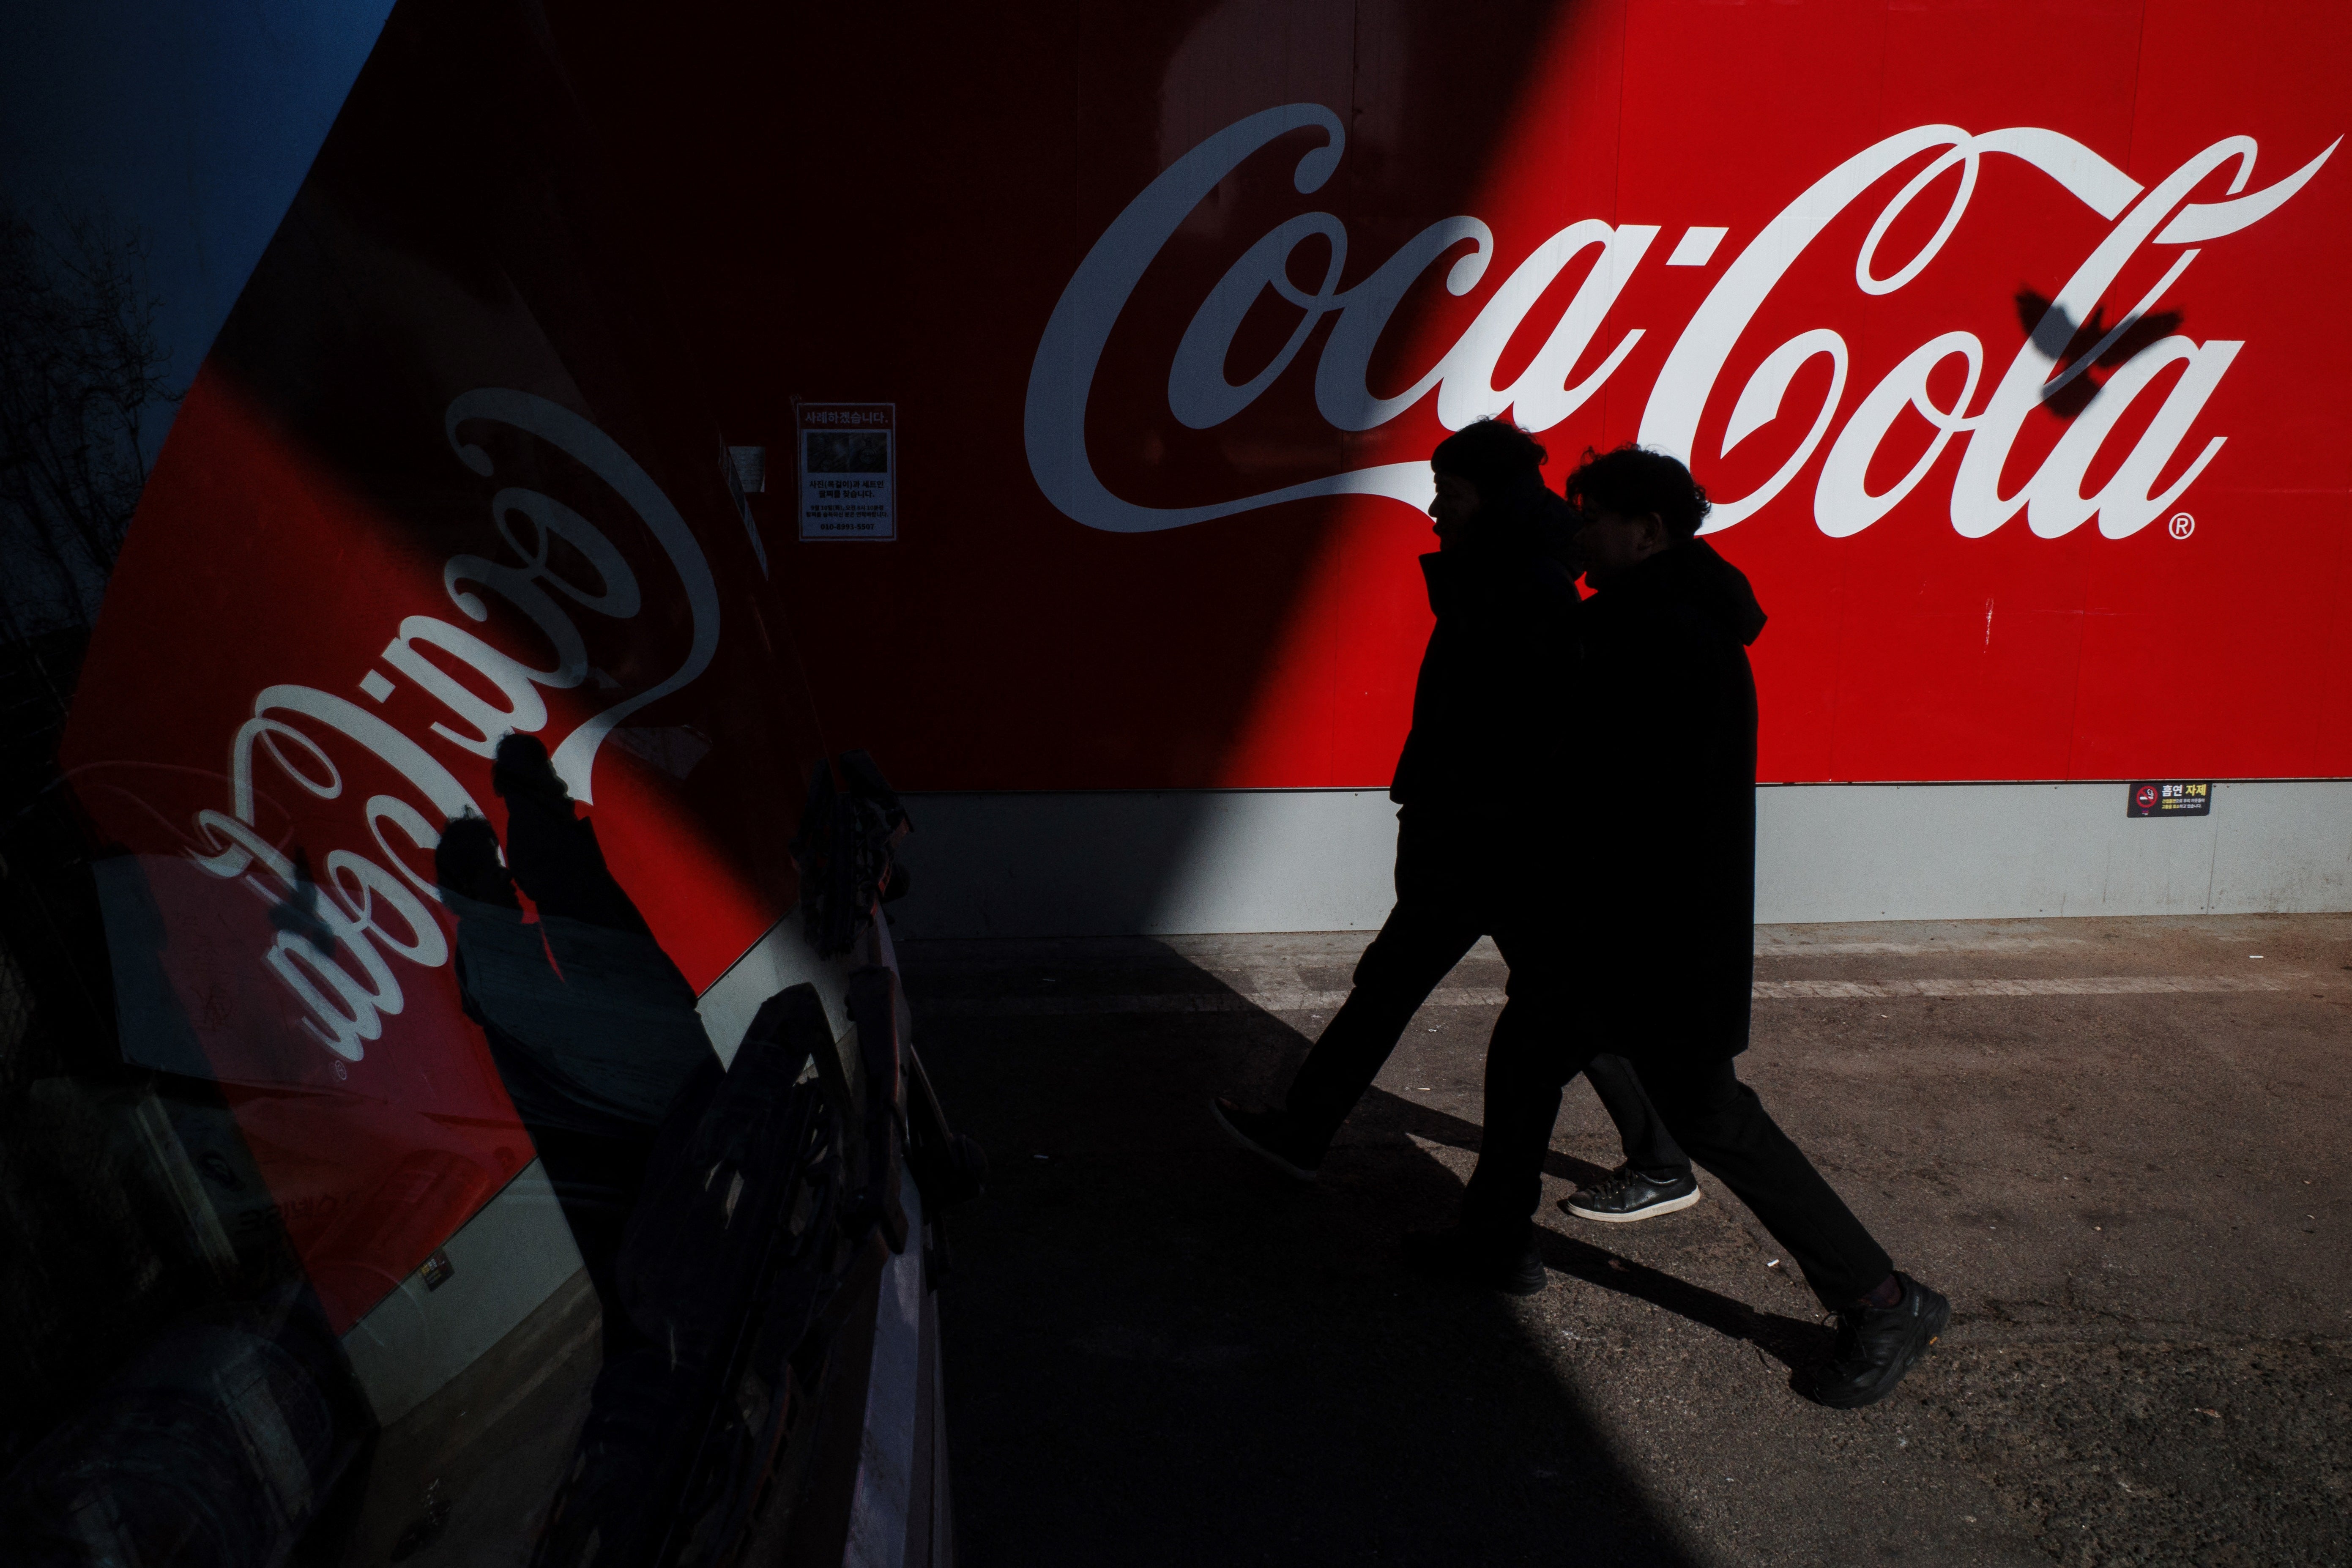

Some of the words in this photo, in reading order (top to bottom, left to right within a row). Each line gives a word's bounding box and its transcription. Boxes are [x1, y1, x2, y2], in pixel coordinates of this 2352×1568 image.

[1024, 102, 2342, 540] Coca-Cola
[805, 411, 888, 424] 사례하겠습니다.
[862, 480, 884, 489] 세트인
[843, 490, 875, 498] 찾습니다.
[2161, 784, 2182, 797] 흡연
[2185, 784, 2207, 796] 자제
